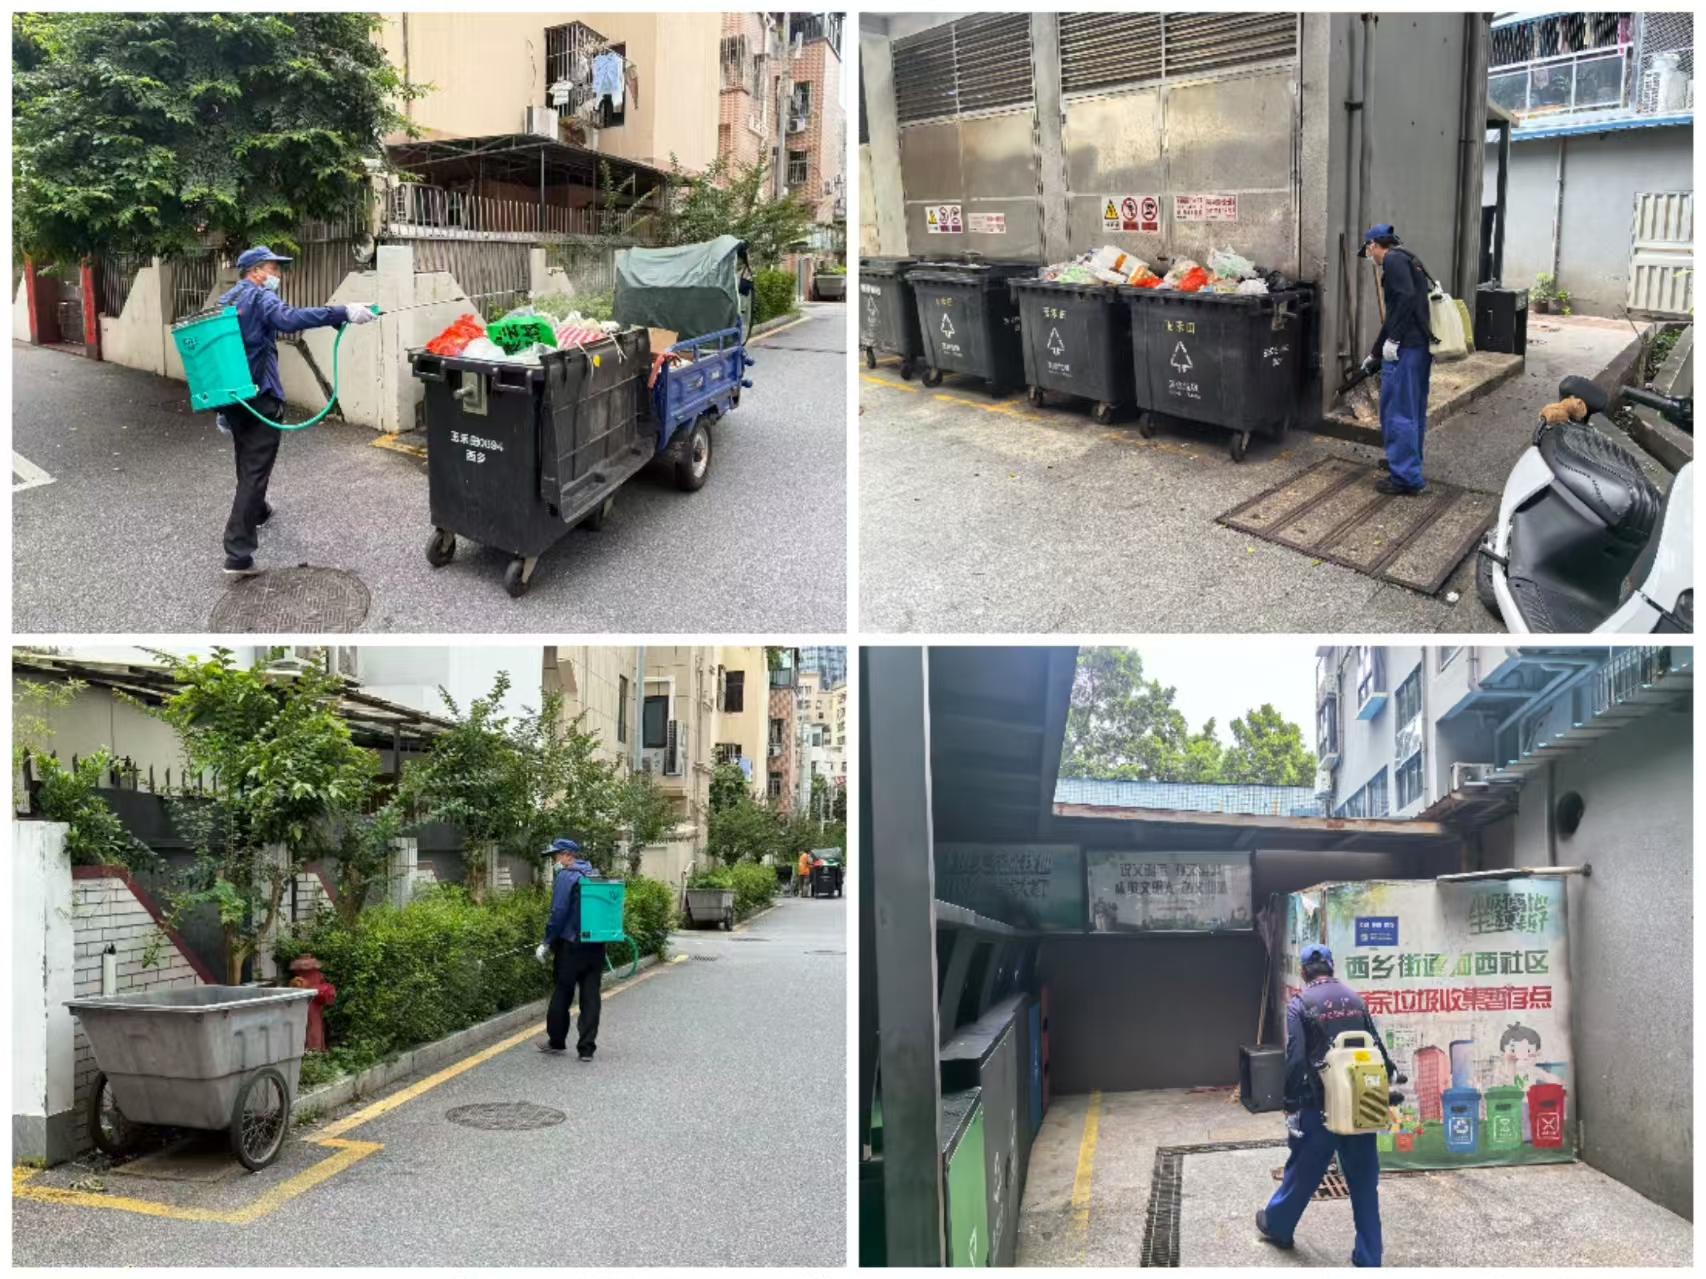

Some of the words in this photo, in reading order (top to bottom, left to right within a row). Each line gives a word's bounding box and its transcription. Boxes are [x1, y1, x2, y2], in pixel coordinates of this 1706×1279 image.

[1357, 986, 1552, 1014] 余垃圾收集暂存点
